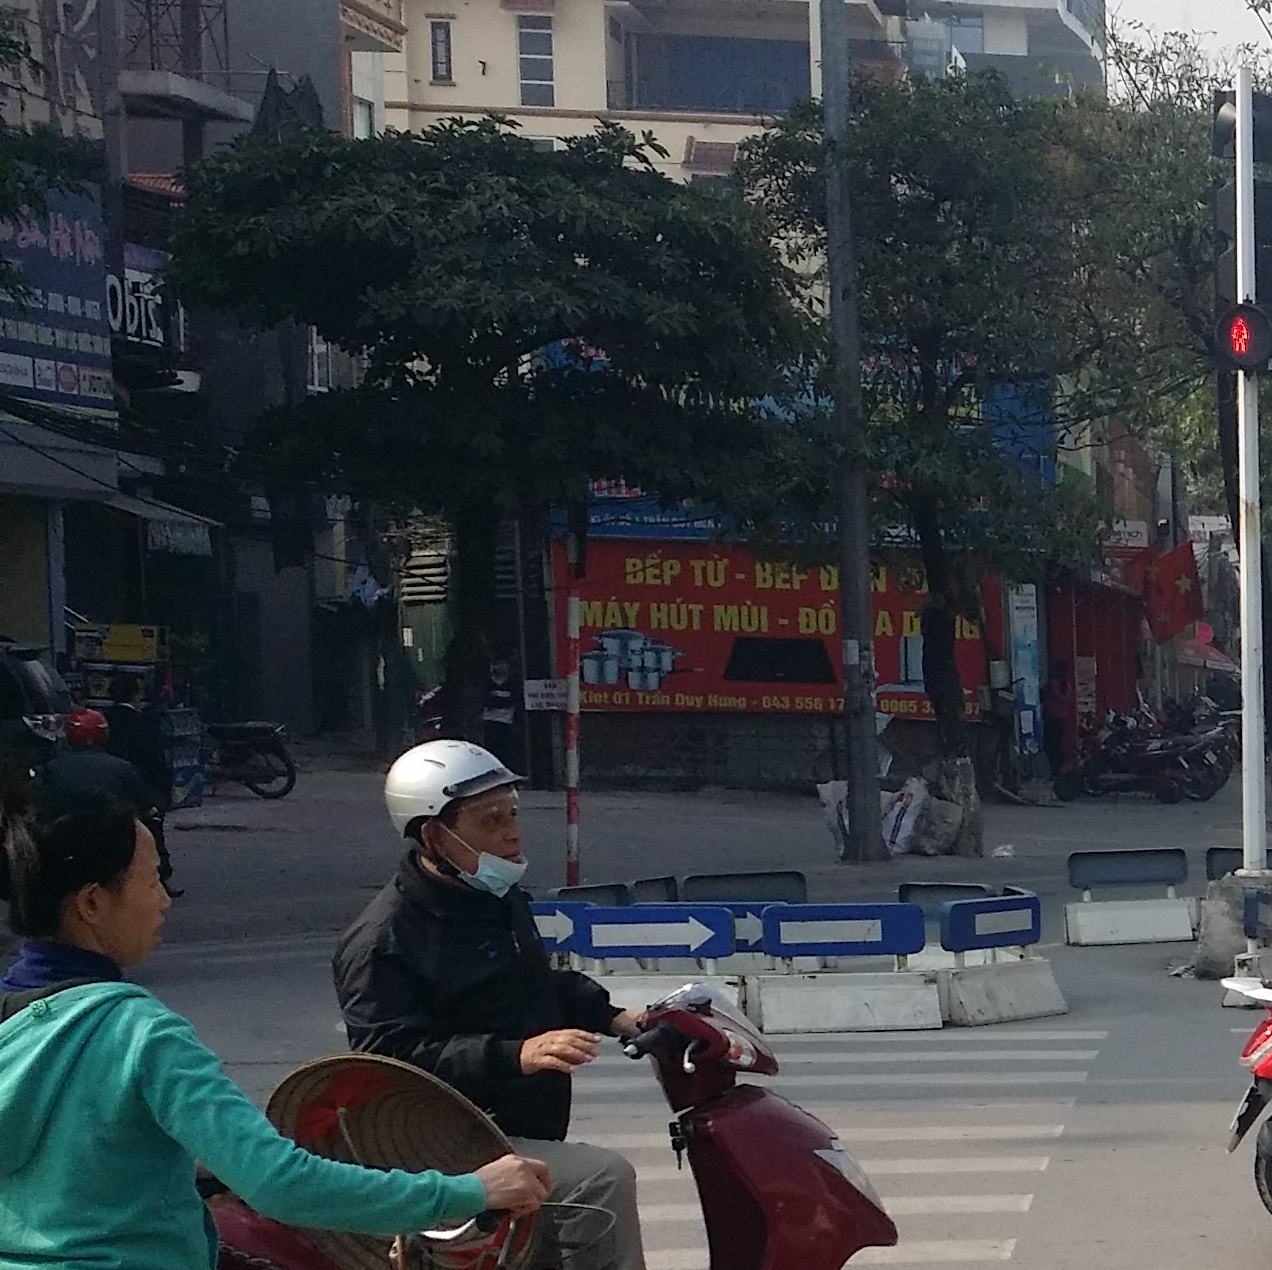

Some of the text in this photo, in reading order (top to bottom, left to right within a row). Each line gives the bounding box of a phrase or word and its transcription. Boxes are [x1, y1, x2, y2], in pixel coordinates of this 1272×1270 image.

[625, 544, 681, 586] BẾP
[689, 553, 729, 588] TỪ
[578, 596, 640, 630] MÁY
[650, 597, 704, 631] HÚT
[713, 599, 769, 633] MÙI
[798, 599, 836, 636] ĐỒ
[674, 692, 705, 709] Duy
